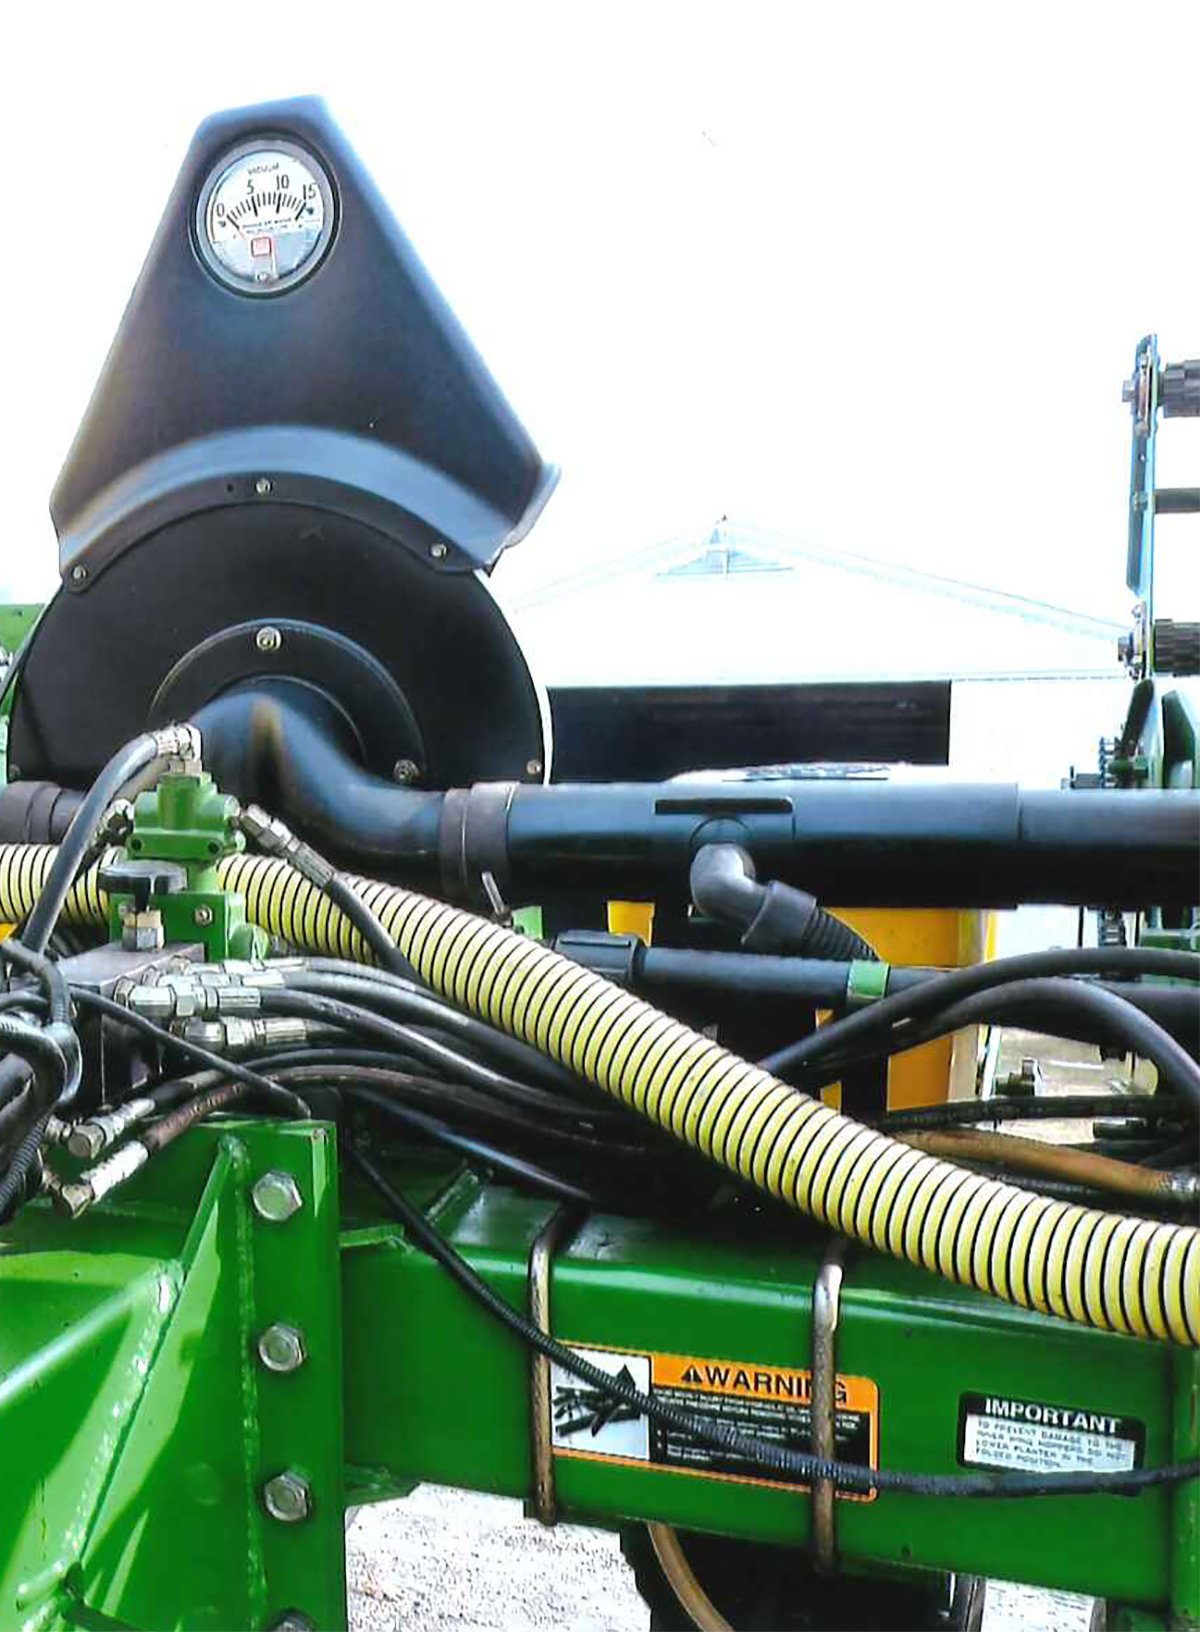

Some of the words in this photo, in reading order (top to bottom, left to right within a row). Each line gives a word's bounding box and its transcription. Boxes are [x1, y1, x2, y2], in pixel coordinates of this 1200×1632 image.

[216, 202, 225, 217] 0
[247, 179, 255, 195] 5
[276, 174, 290, 190] 10
[302, 181, 318, 200] 15
[985, 1397, 1121, 1434] IMPORTANT
[994, 1423, 1036, 1437] PREVENT
[1041, 1430, 1082, 1444] DAMAGE
